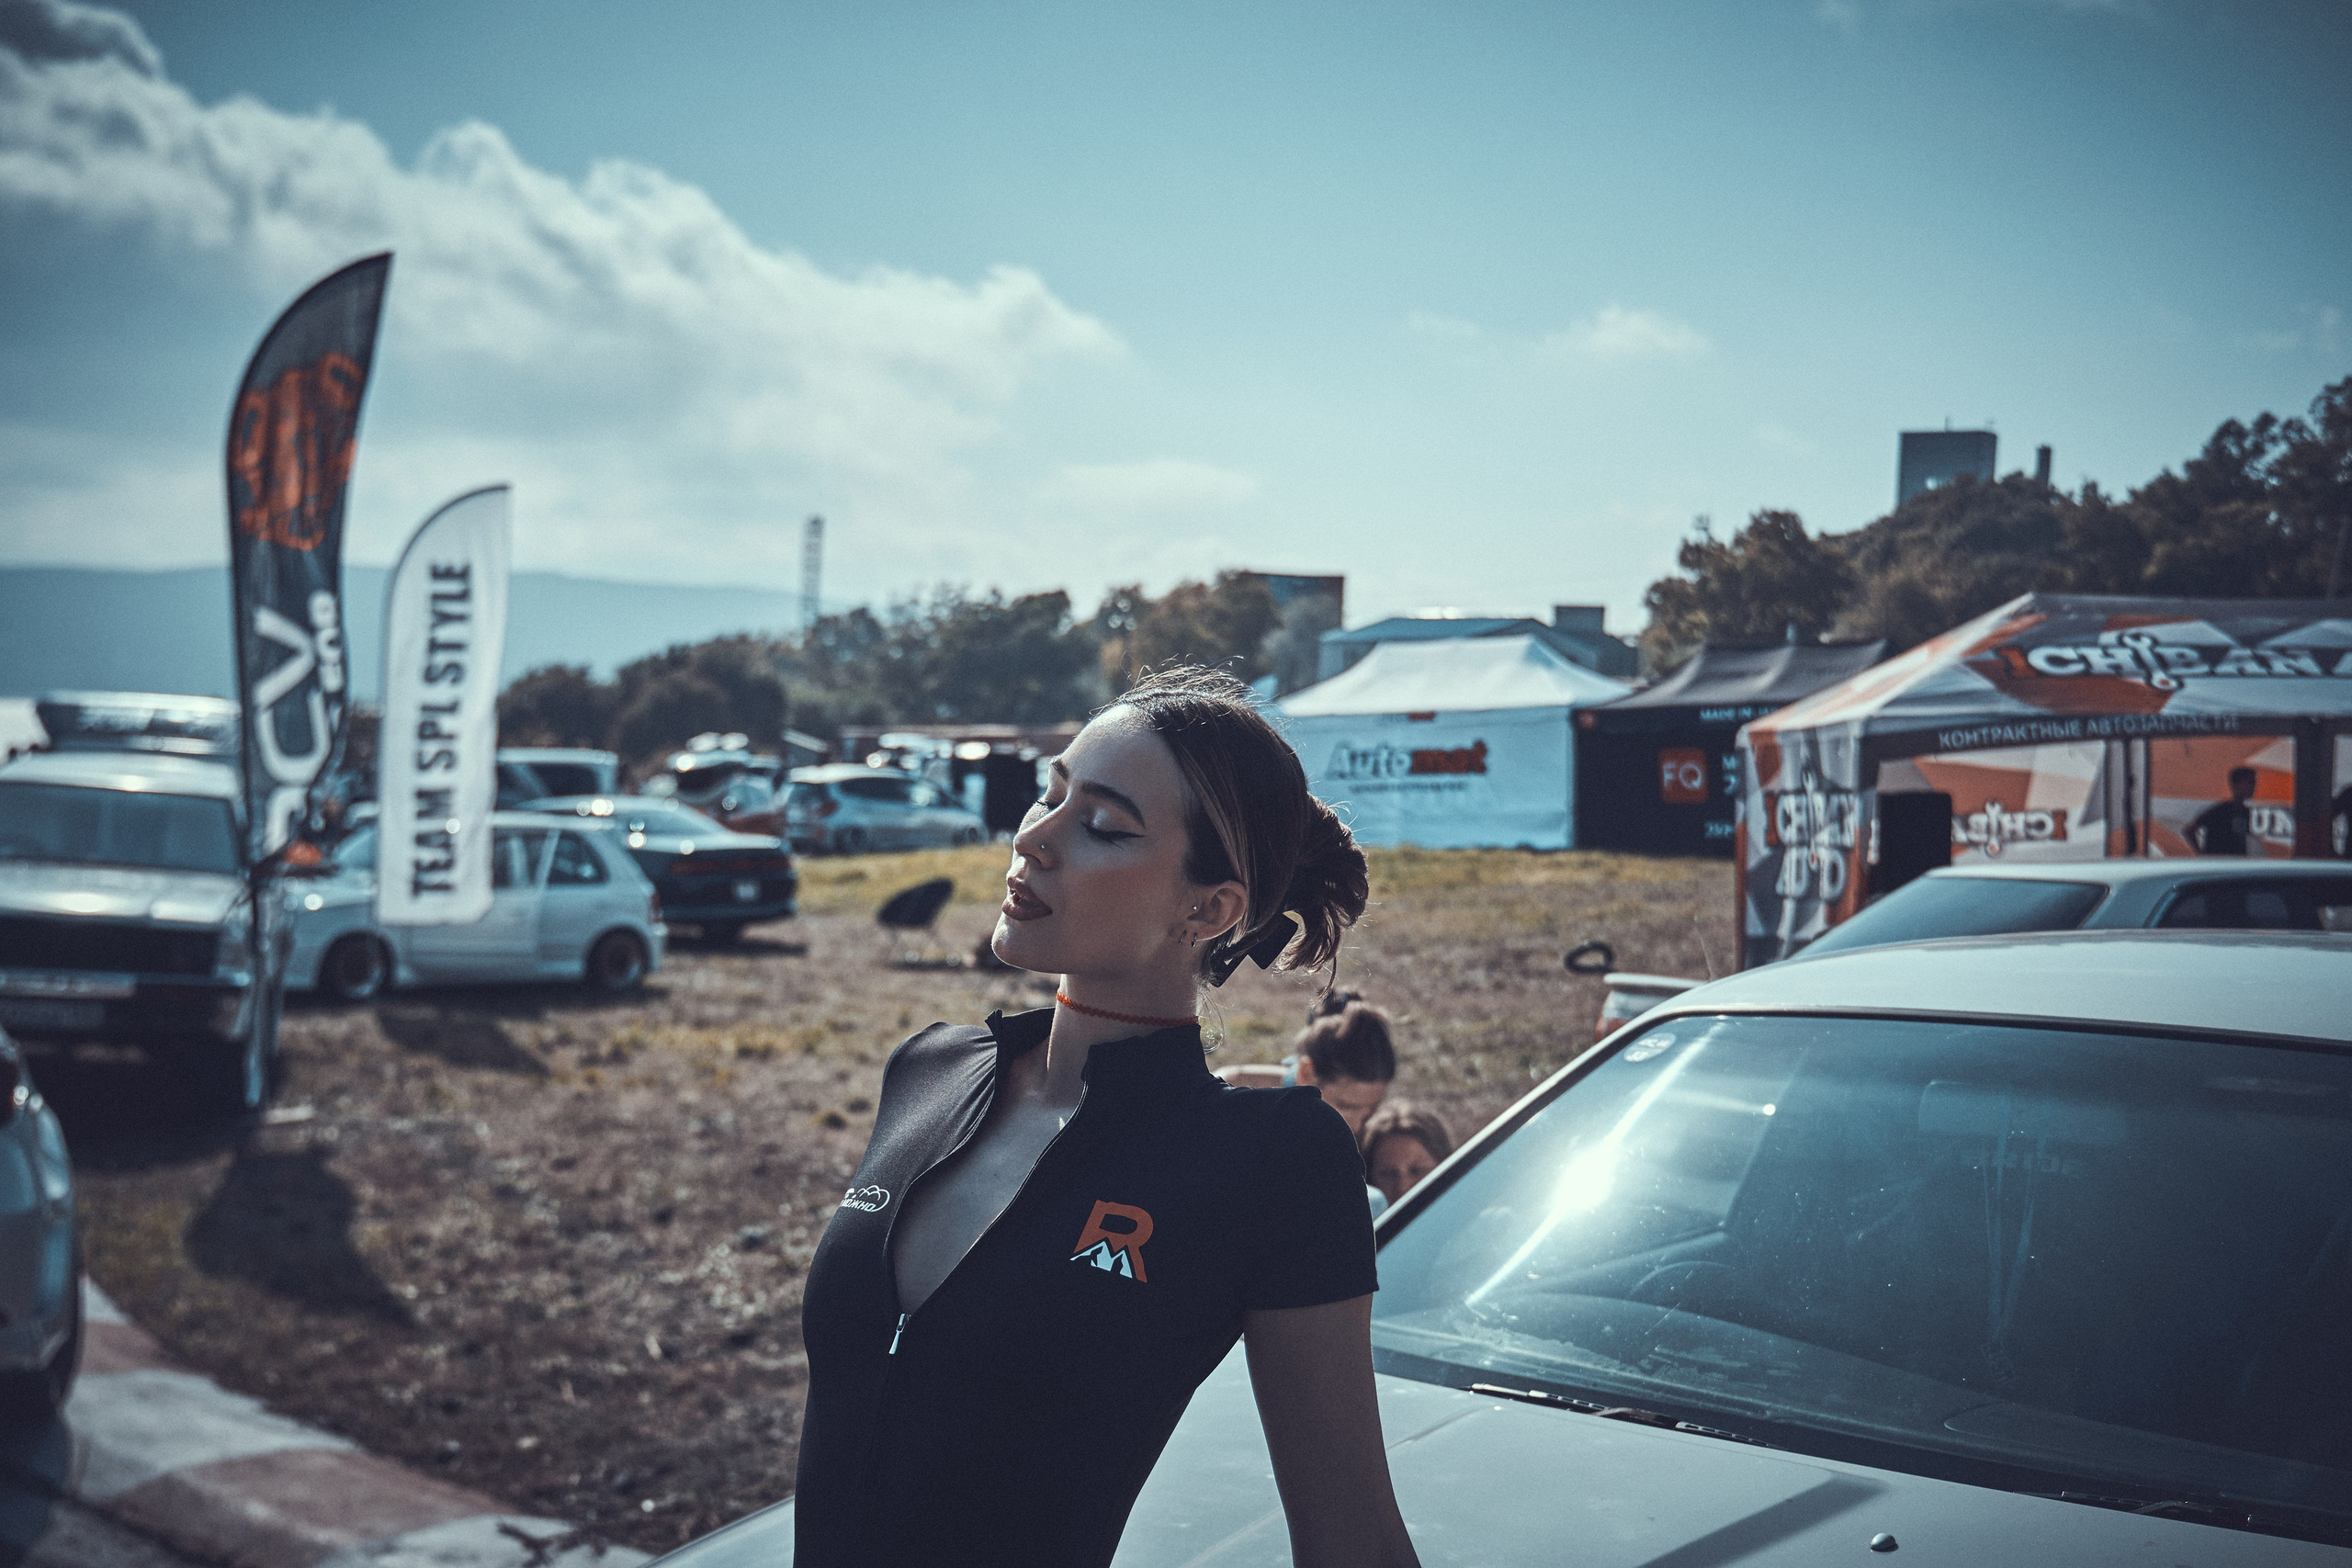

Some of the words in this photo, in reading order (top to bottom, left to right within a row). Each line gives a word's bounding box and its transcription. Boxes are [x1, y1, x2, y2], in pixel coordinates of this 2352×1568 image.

[422, 561, 471, 687] STYLE
[415, 698, 459, 773] SPL
[1939, 718, 2082, 750] КОНТРАКТНЫЕ
[1661, 761, 1702, 790] FQ
[411, 787, 457, 900] TEAM
